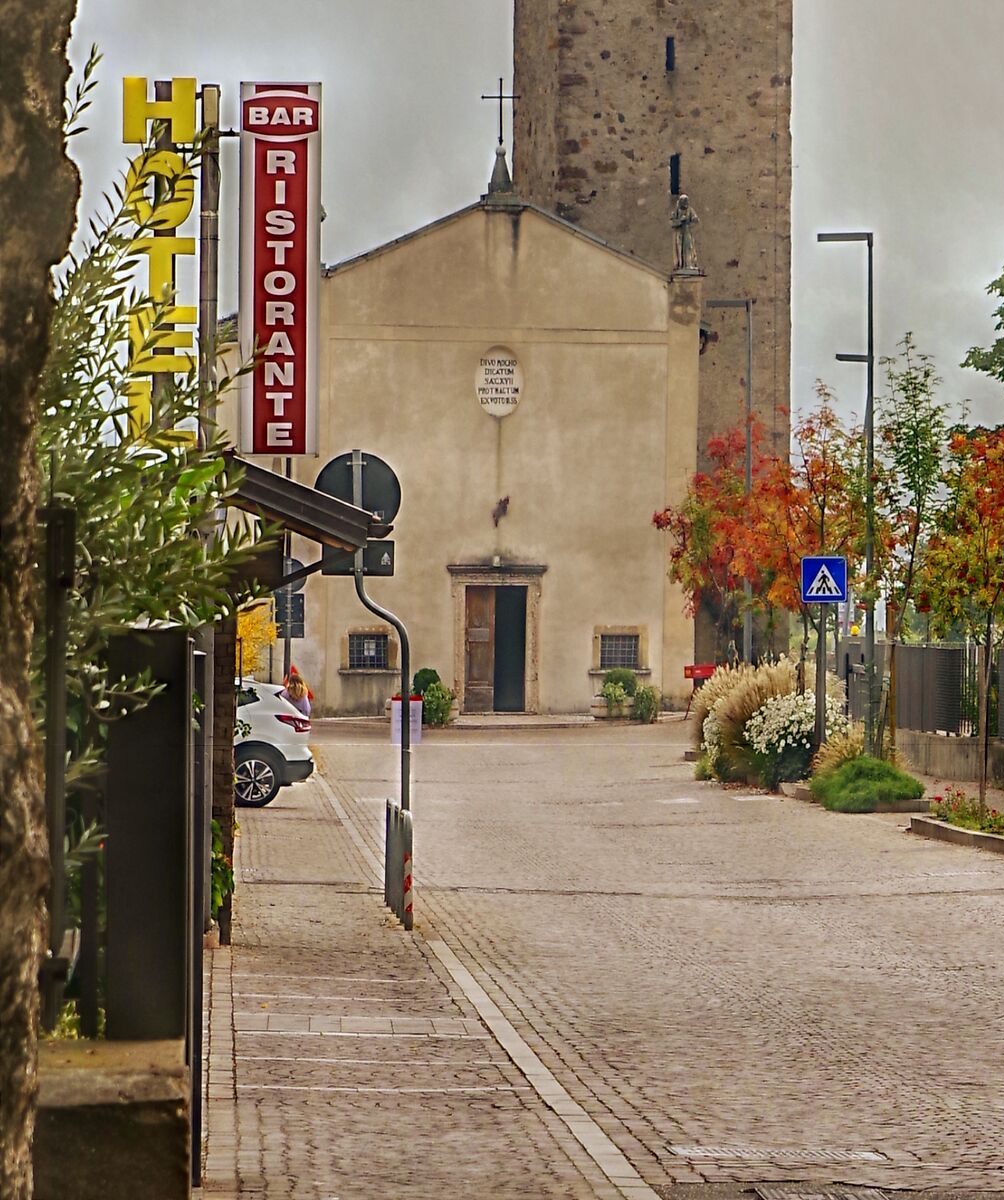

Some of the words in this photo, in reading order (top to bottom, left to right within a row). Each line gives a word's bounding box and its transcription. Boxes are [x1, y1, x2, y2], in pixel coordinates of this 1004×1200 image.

[122, 77, 198, 448] HOTEL
[248, 106, 314, 126] BAR
[263, 149, 297, 447] RISTORANTE
